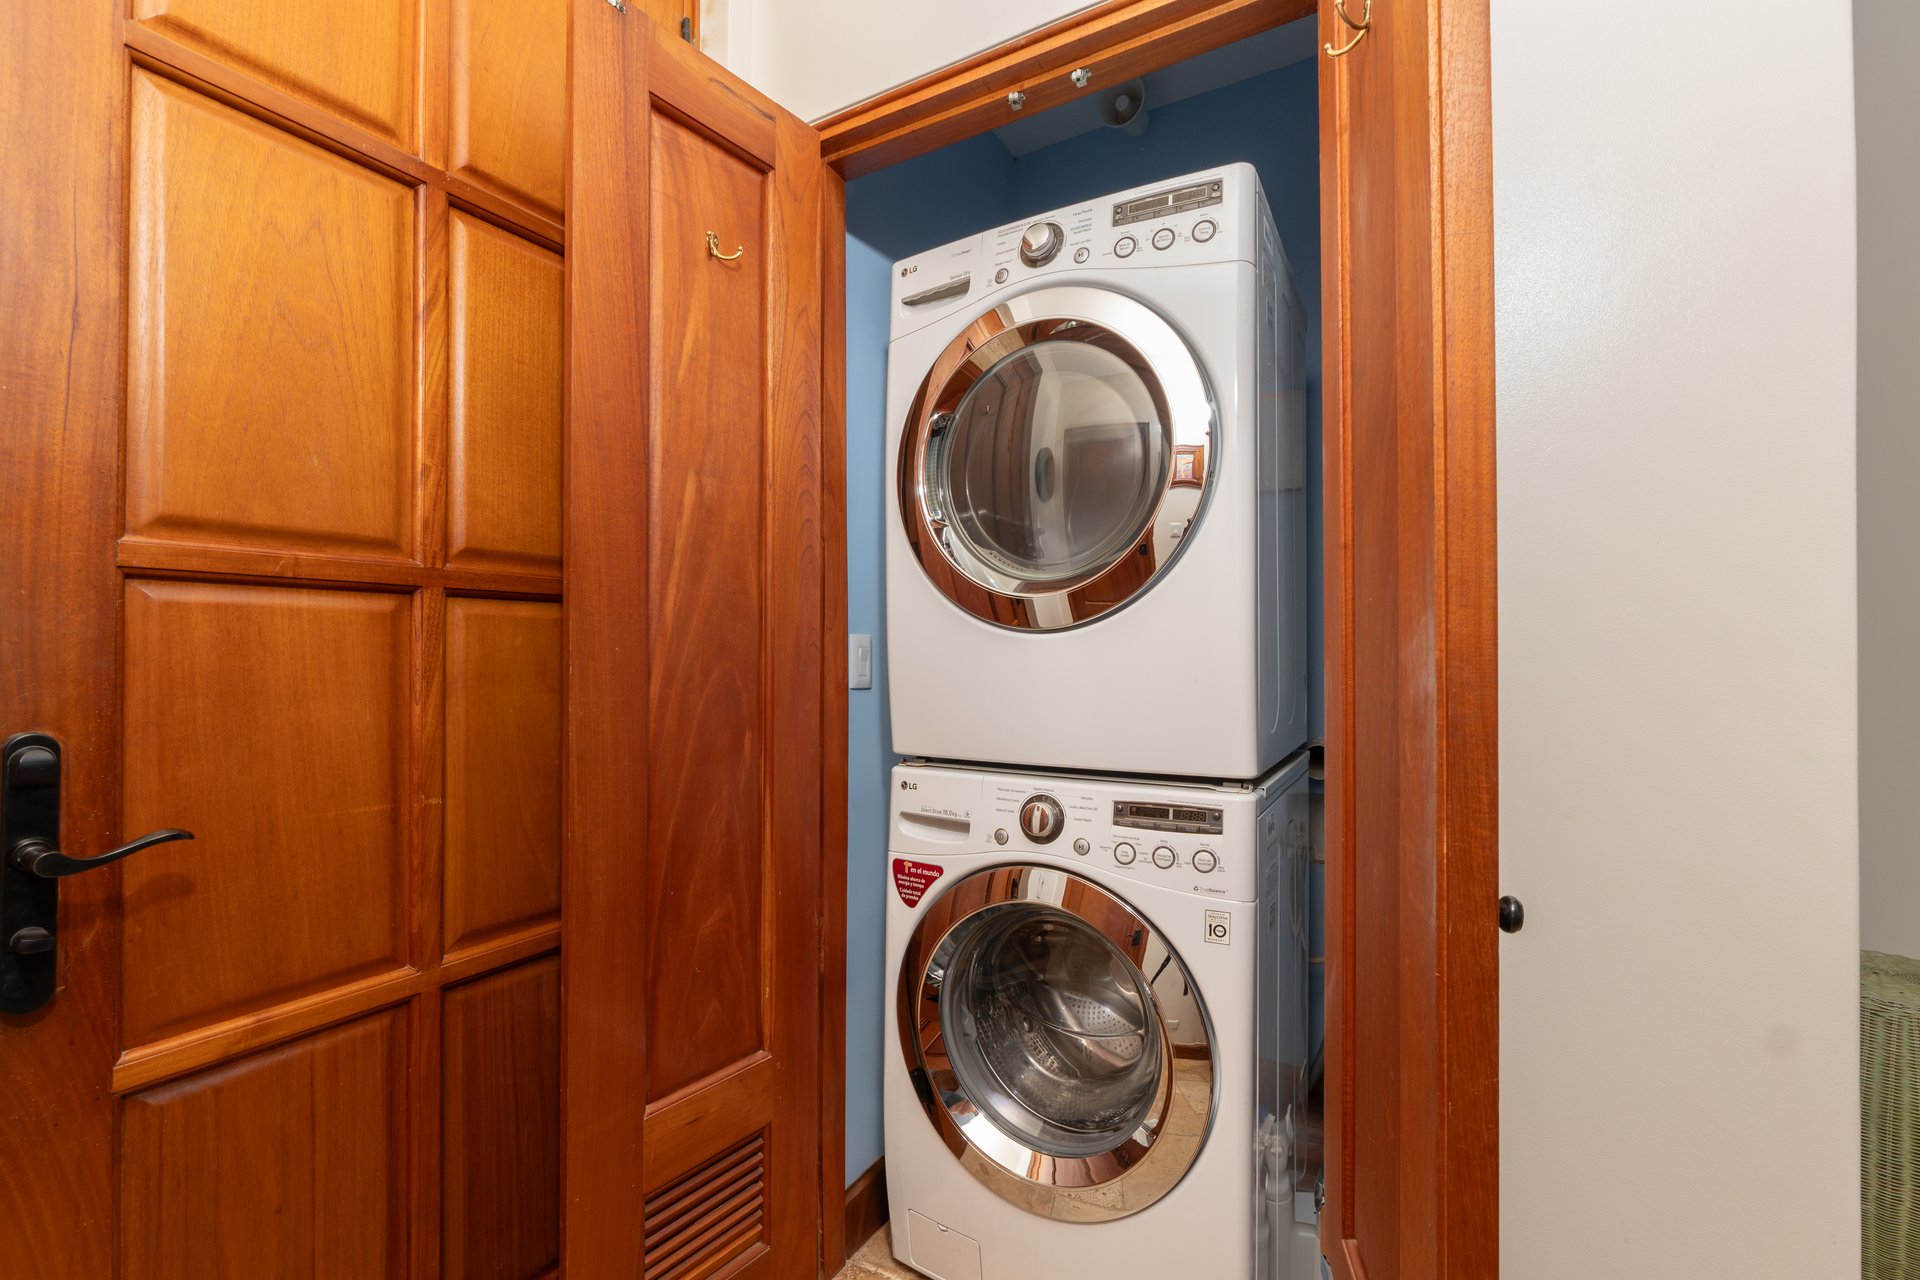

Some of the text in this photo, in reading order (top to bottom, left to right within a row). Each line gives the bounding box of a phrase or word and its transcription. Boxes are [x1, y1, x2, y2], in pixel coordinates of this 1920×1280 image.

[909, 265, 917, 274] LG
[923, 869, 940, 877] mundo
[1208, 924, 1227, 938] 10
